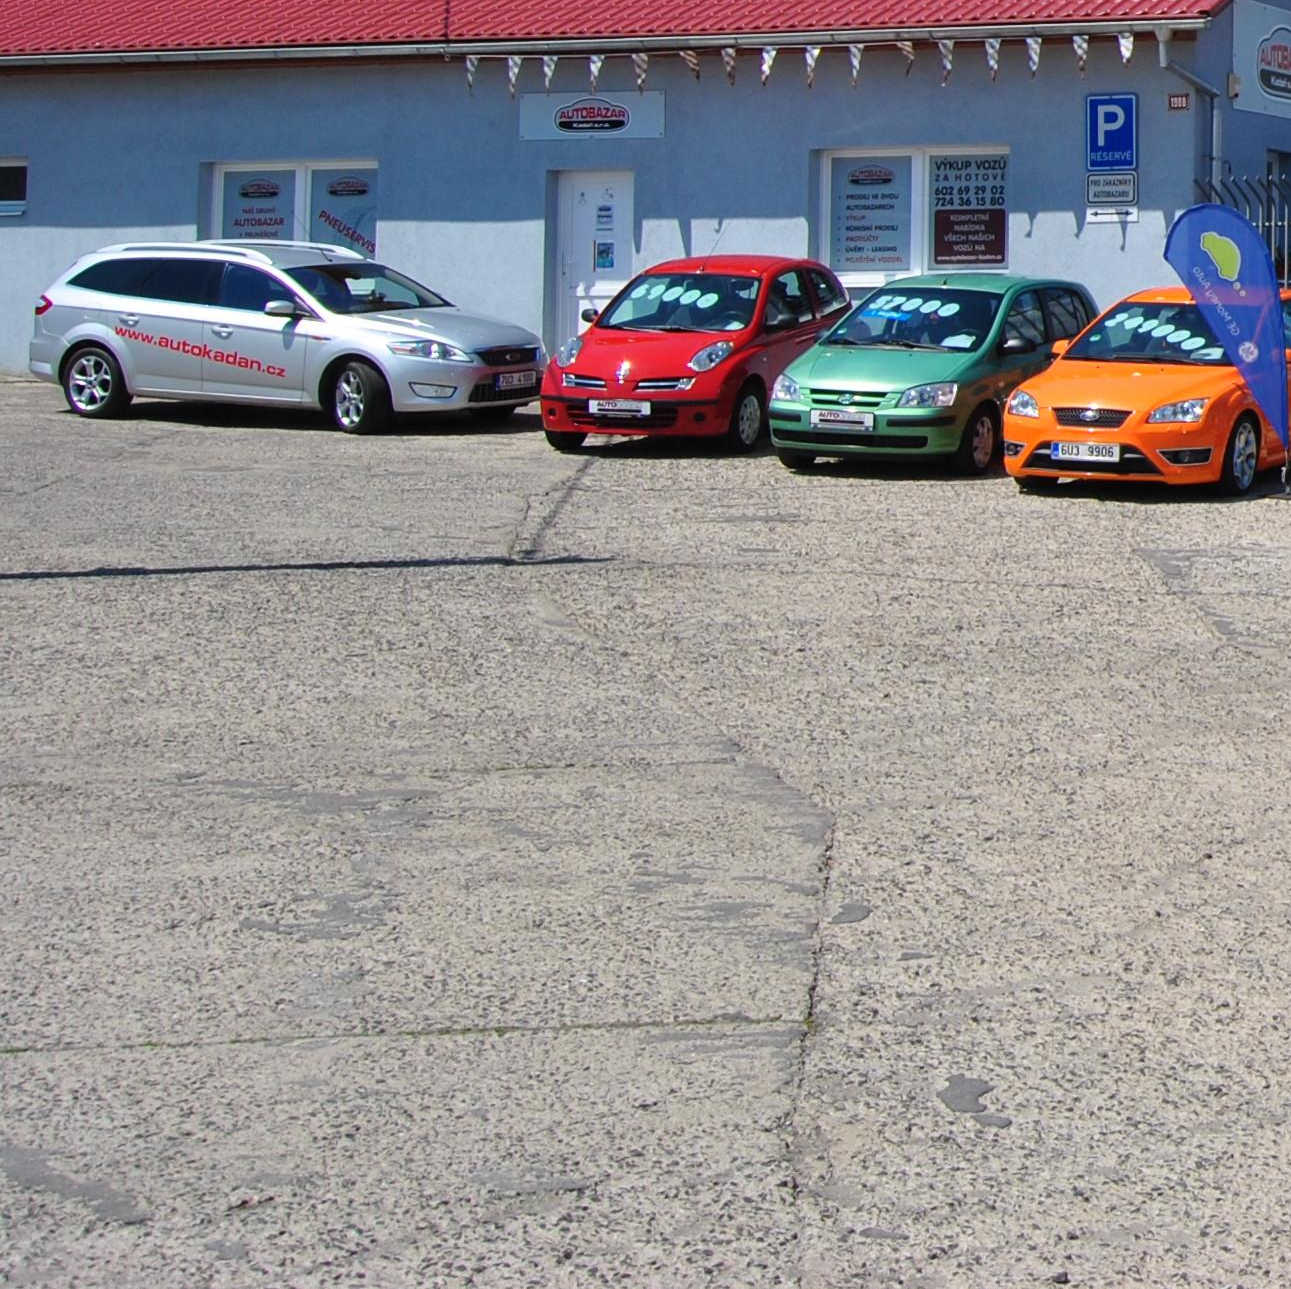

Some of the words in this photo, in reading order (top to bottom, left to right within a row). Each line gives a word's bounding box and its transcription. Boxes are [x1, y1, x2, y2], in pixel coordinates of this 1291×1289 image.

[559, 107, 626, 119] AUTOBAZAR
[1097, 104, 1125, 147] P
[935, 158, 971, 171] VÝKUP
[975, 157, 1007, 171] VOZŮ
[1090, 179, 1101, 187] PRO
[934, 186, 954, 196] 602
[957, 186, 970, 196] 69
[974, 186, 987, 195] 29
[990, 185, 1005, 195] 02
[935, 197, 954, 207] 724
[958, 197, 971, 206] 36
[975, 197, 986, 206] 15
[990, 196, 1005, 206] 80
[233, 217, 285, 227] AUTOBAZAR
[318, 210, 376, 254] PNEUSERVIS
[115, 326, 286, 378] www.autokadan.cz
[1061, 444, 1080, 456] 6U3
[1088, 444, 1114, 457] 9906
